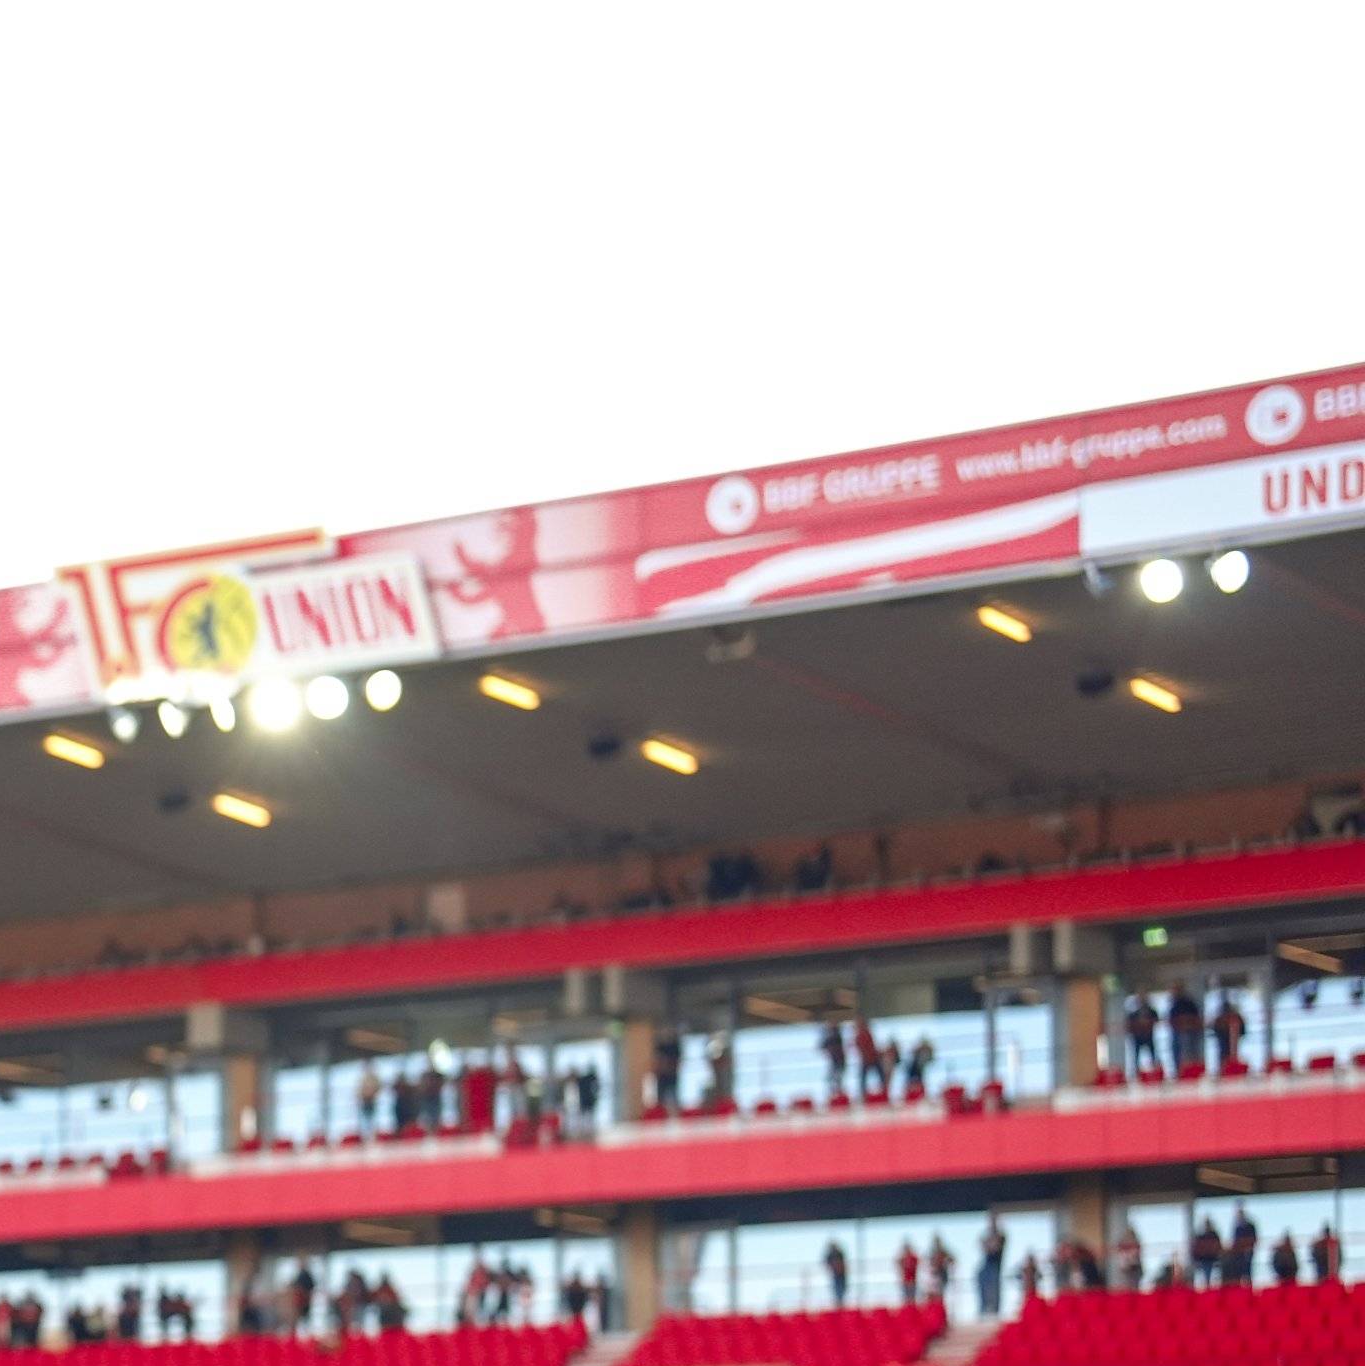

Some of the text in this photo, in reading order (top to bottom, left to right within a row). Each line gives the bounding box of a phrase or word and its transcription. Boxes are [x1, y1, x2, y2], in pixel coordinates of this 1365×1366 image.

[762, 413, 1229, 513] BBF GRUPPE www.bbf-gruppe.com
[261, 573, 417, 656] UNION
